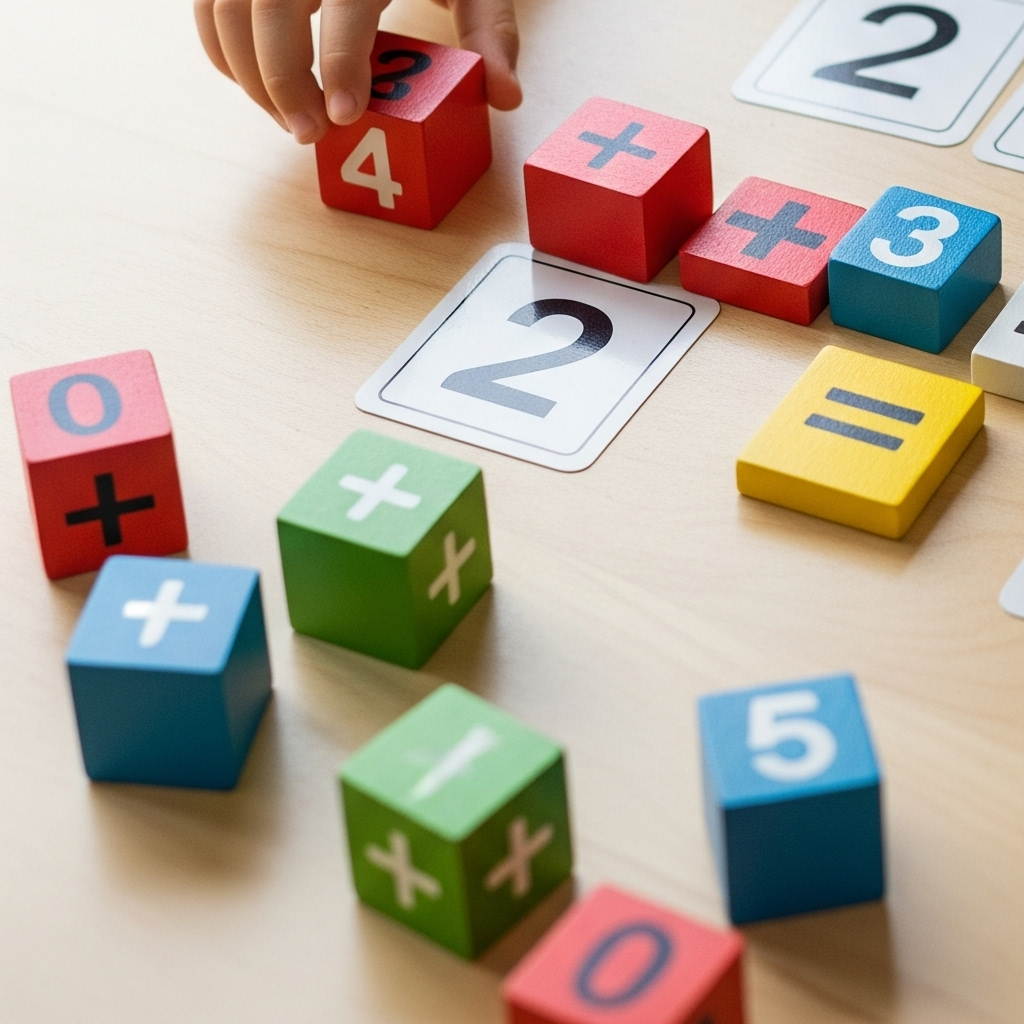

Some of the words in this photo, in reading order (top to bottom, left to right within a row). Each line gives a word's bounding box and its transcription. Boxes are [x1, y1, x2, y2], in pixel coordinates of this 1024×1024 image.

[811, 3, 959, 99] 2
[341, 127, 403, 209] 4
[870, 205, 960, 267] 3
[440, 298, 614, 419] 2
[747, 689, 838, 782] 5
